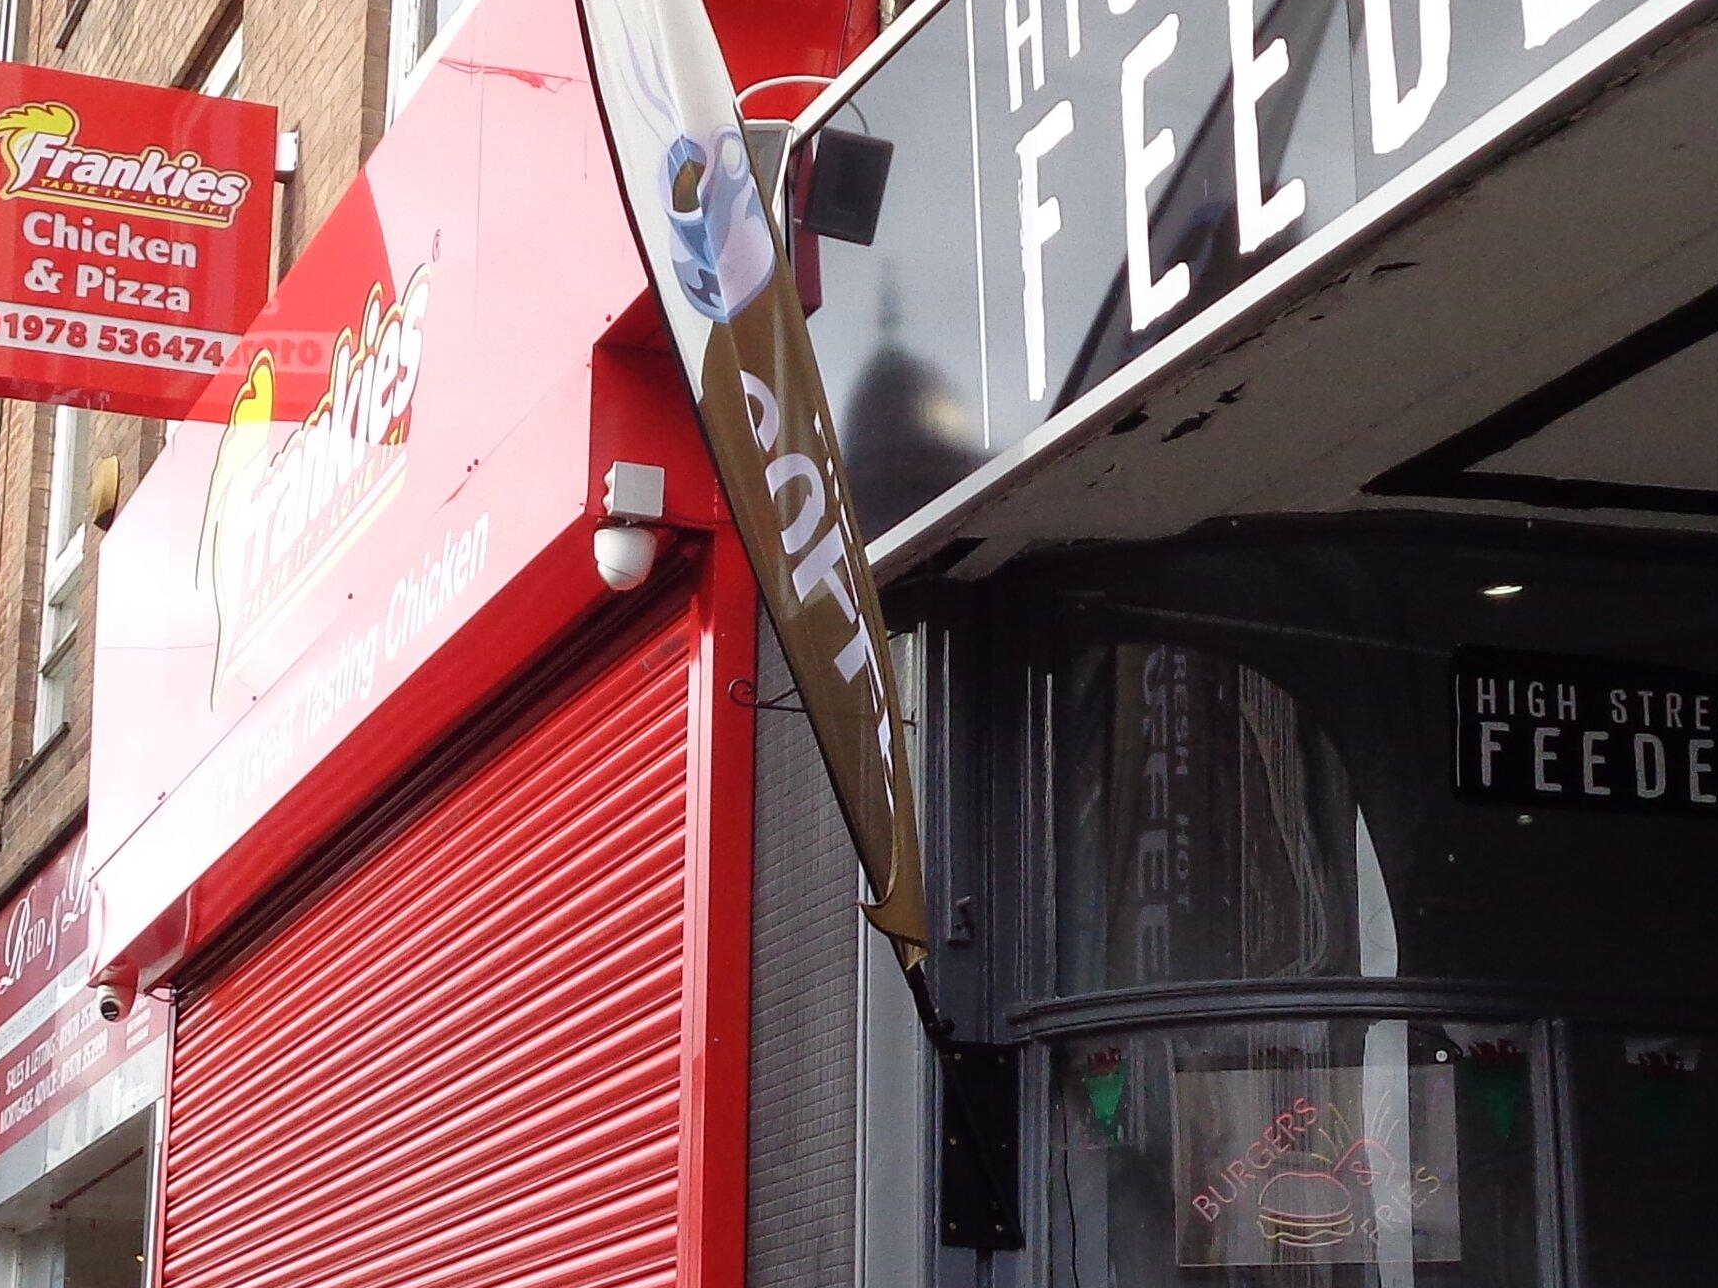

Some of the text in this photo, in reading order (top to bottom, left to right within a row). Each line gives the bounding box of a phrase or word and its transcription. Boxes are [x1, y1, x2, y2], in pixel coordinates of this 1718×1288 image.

[10, 130, 246, 206] Frankies
[39, 179, 97, 195] TASTE
[104, 188, 122, 198] IT
[145, 197, 194, 210] LOVE
[23, 211, 198, 268] Chicken
[24, 258, 190, 312] & Pizza
[97, 325, 224, 366] 536474
[384, 511, 490, 661] Chicken
[1477, 677, 1577, 721] HIGH
[1193, 1098, 1317, 1222] BURGERS
